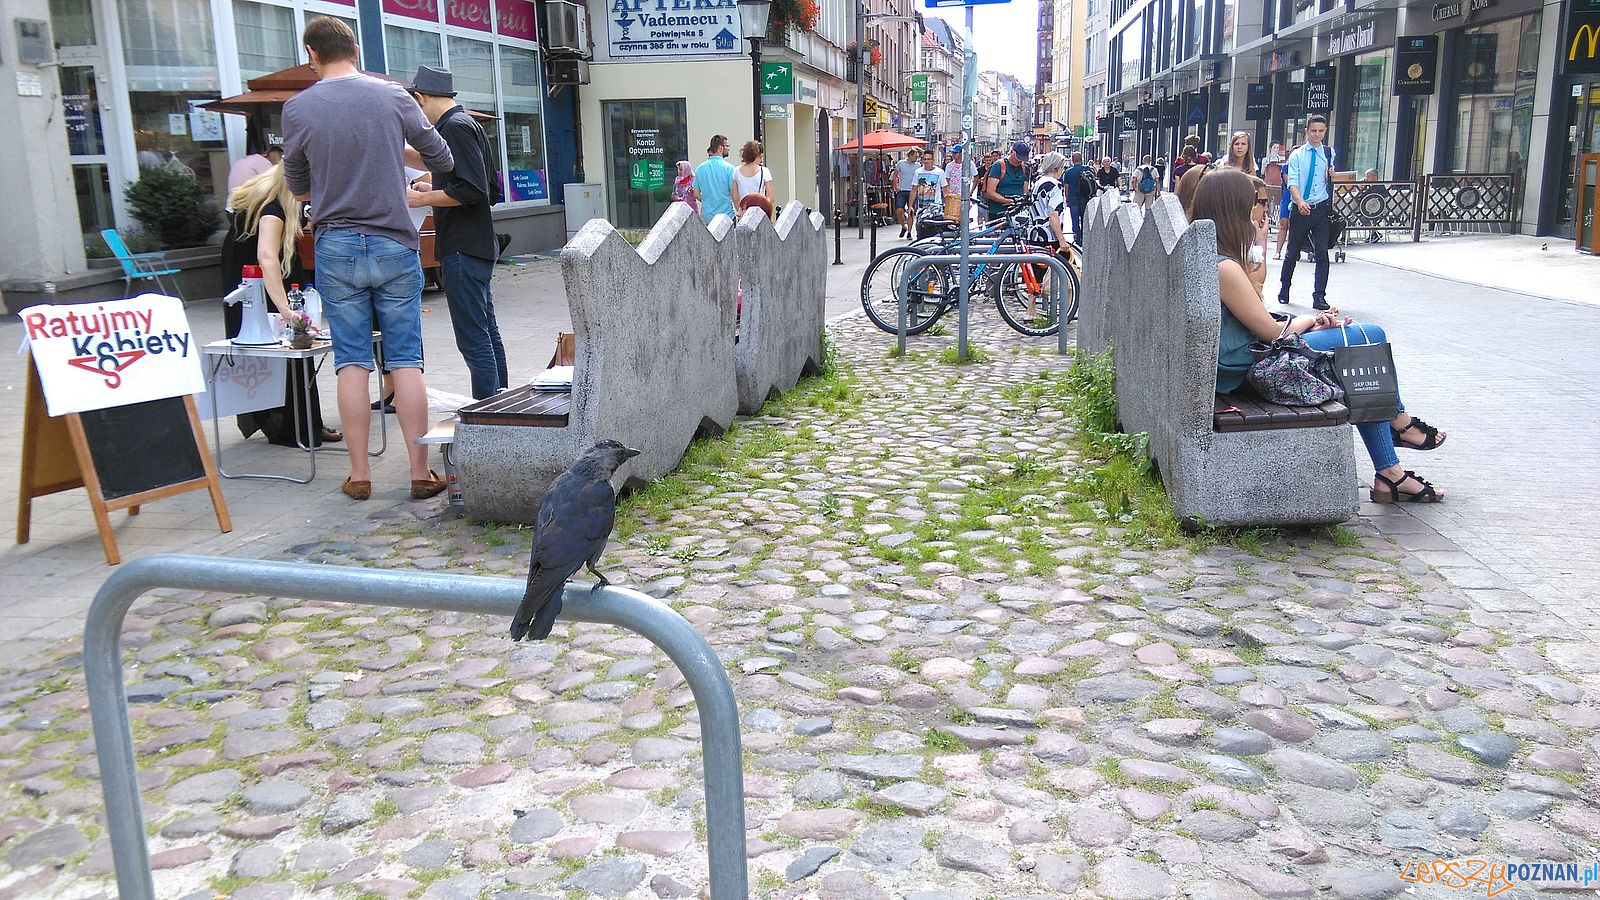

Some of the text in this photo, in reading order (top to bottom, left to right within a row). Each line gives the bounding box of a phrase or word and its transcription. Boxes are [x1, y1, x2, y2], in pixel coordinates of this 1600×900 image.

[1328, 20, 1374, 56] Jean Louis David
[619, 44, 648, 52] czynna
[650, 42, 664, 50] 365
[666, 41, 679, 49] dni
[691, 41, 709, 49] roku
[1307, 83, 1326, 92] Jean
[1307, 91, 1329, 100] Louis
[1307, 100, 1329, 109] David
[628, 146, 664, 155] Optymalne
[25, 306, 153, 341] Ratujmy
[72, 329, 189, 357] Kobiety
[1342, 366, 1387, 377] MOHITO
